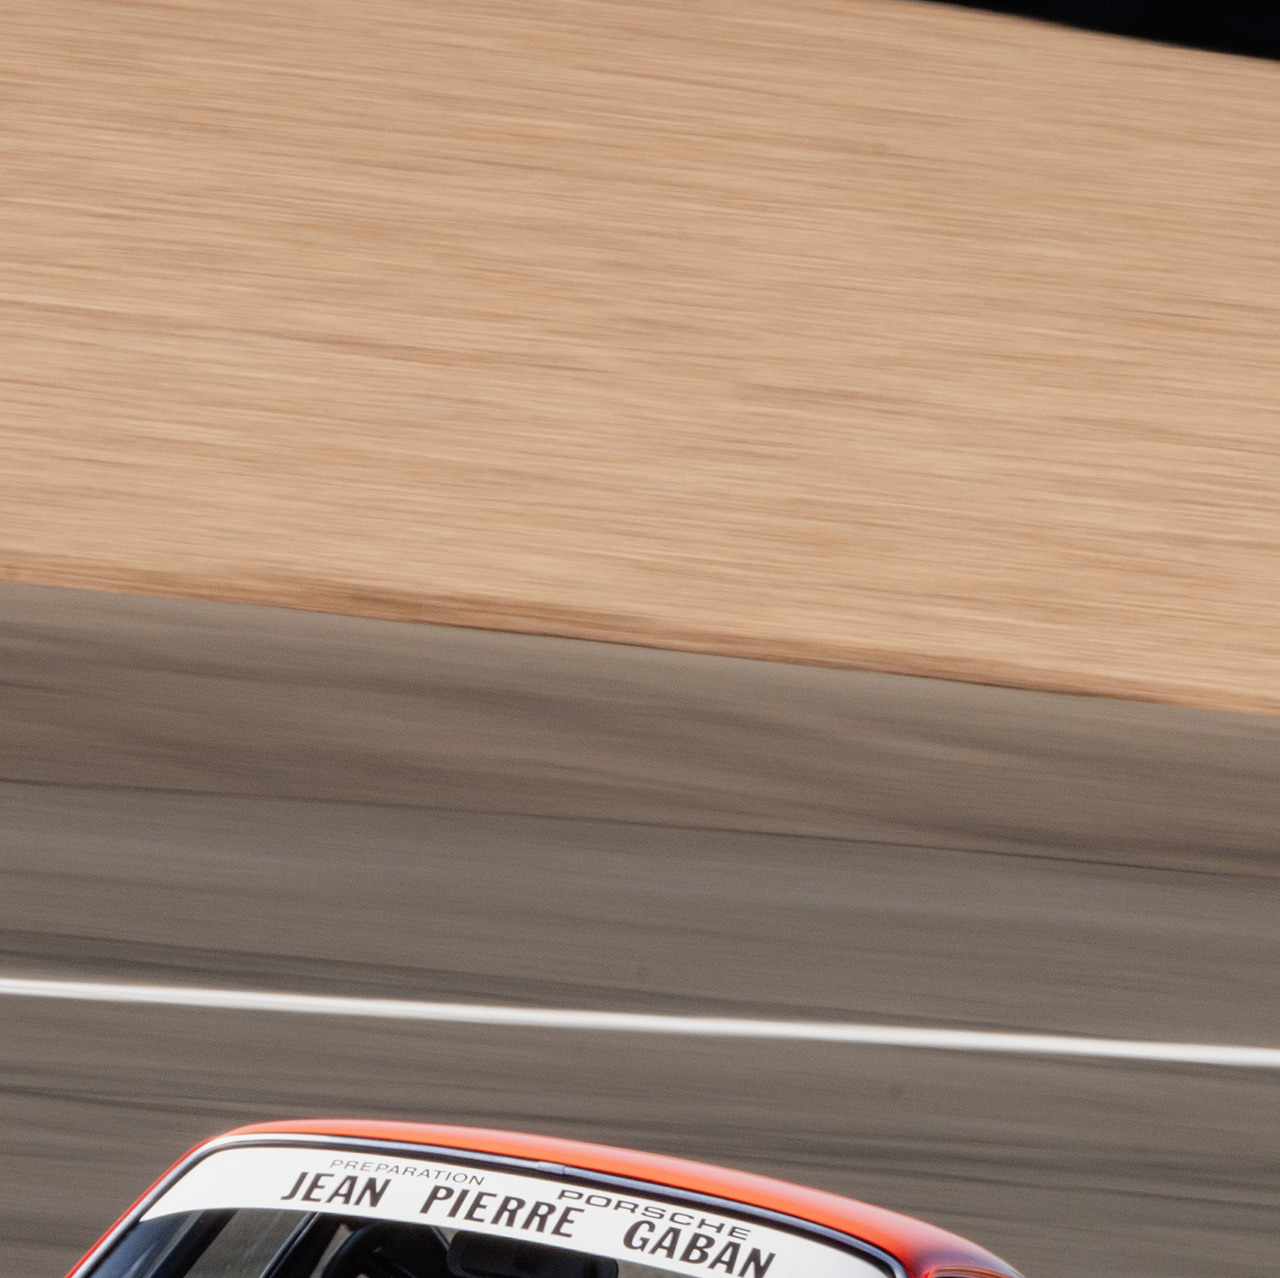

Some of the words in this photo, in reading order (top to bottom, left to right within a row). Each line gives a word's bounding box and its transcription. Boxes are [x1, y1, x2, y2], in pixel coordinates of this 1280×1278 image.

[329, 1159, 485, 1186] PREPARATION
[280, 1171, 393, 1208] JEAN
[419, 1184, 586, 1239] PIERRE
[557, 1189, 752, 1241] PORSCHE
